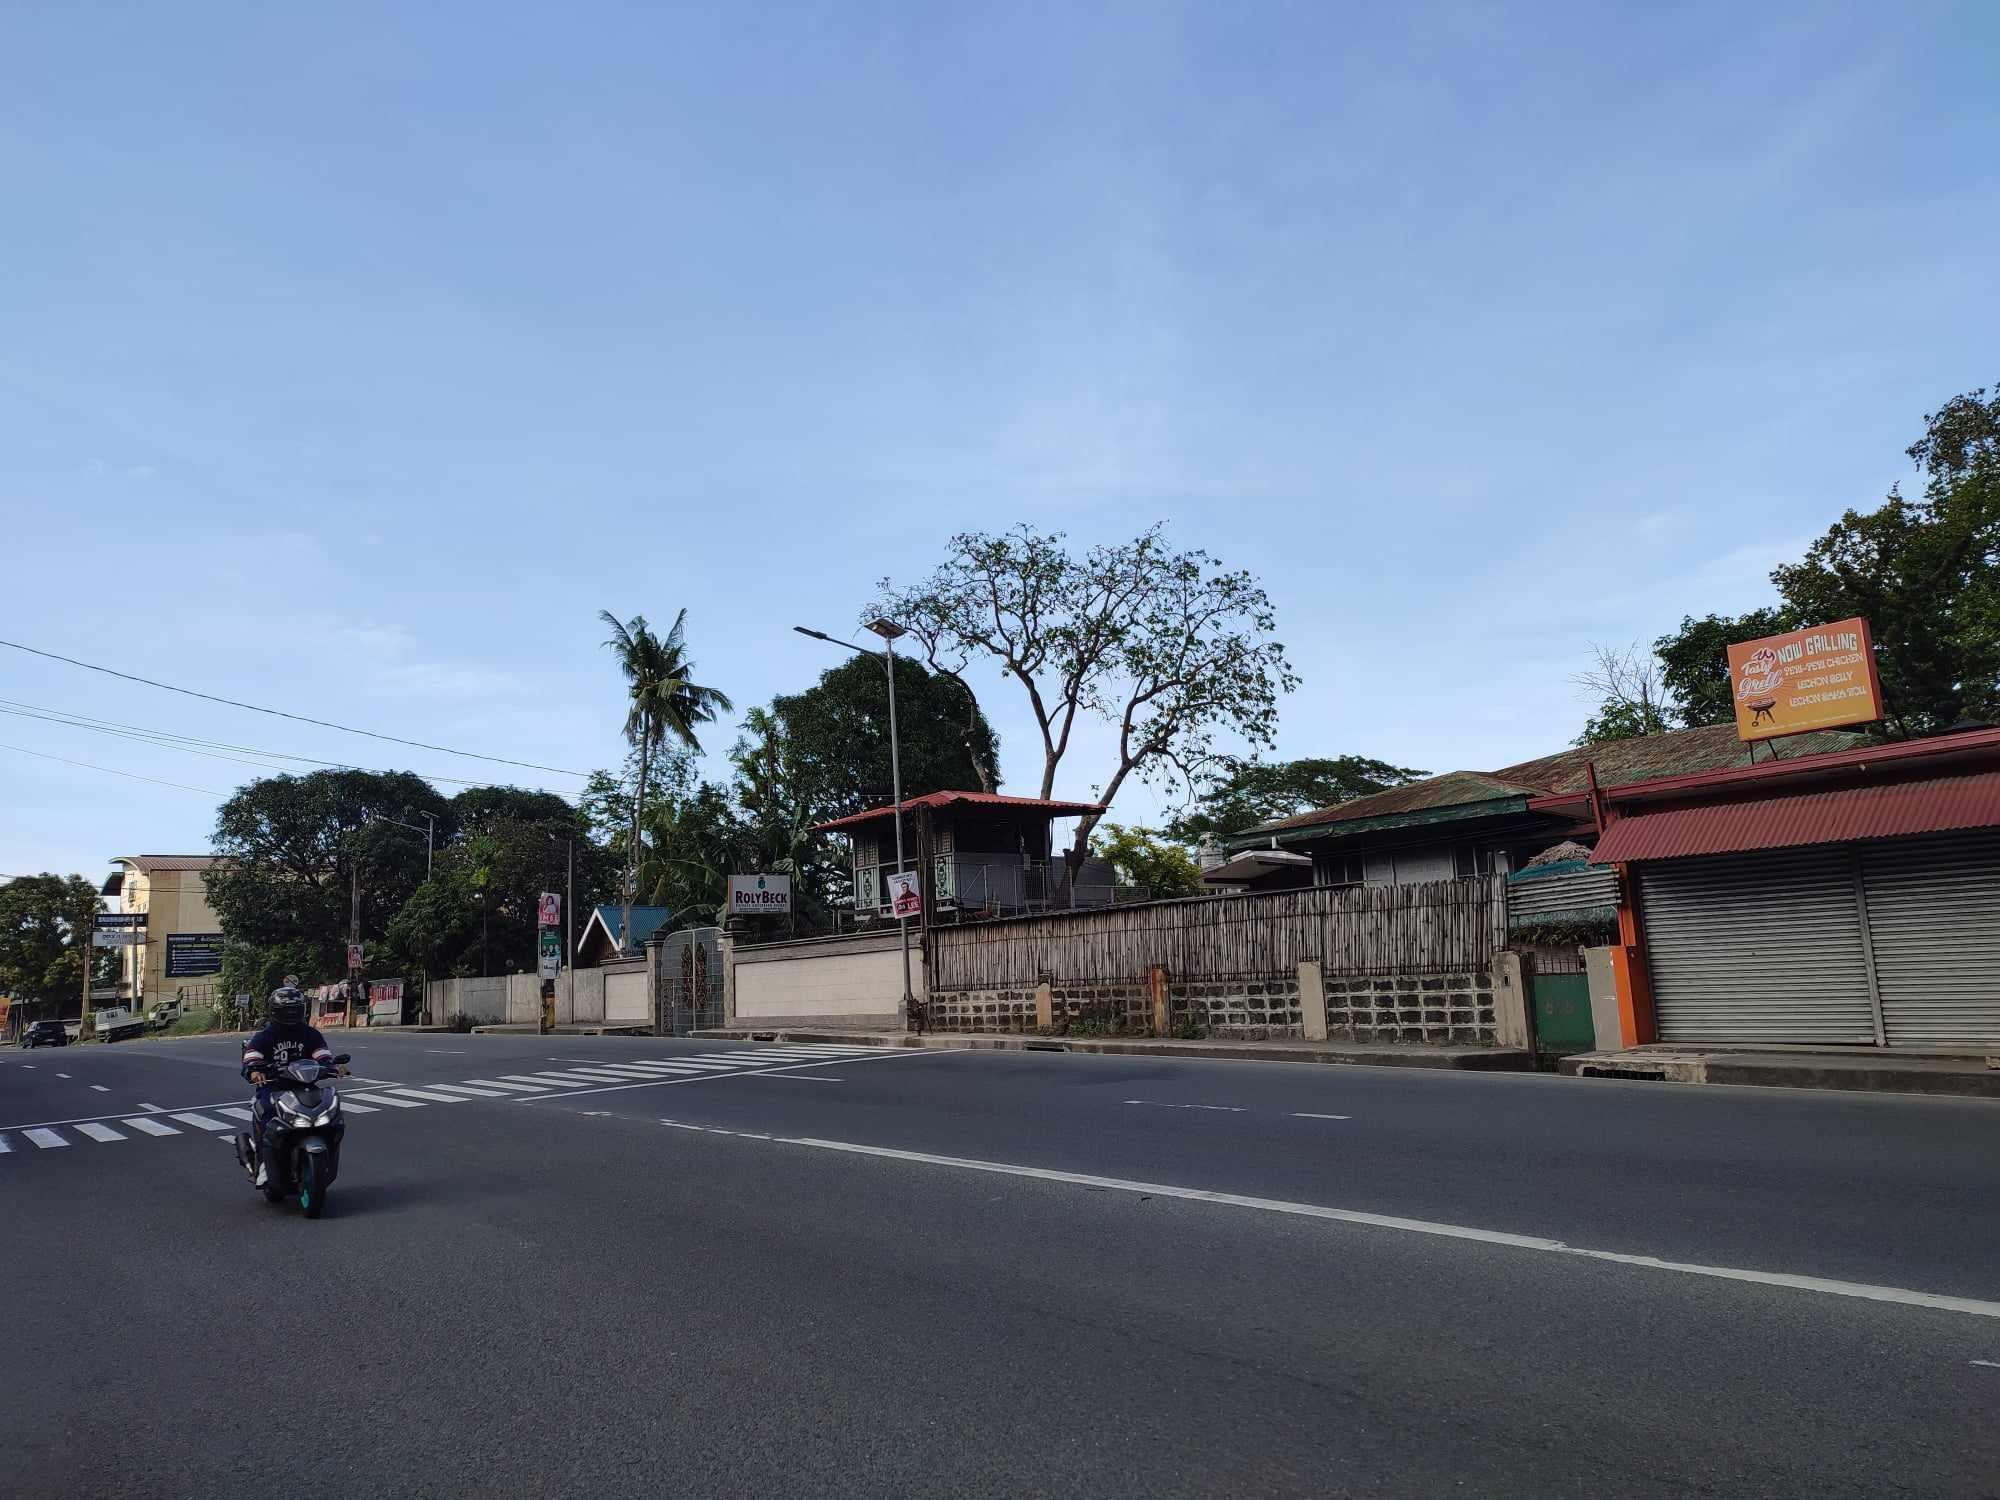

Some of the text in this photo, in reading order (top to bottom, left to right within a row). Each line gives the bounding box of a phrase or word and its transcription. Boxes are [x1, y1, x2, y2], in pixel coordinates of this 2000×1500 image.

[1777, 633, 1857, 663] NOW GRILLING
[1826, 653, 1863, 667] CHICKEN
[1797, 671, 1854, 690] LECHON BELLY
